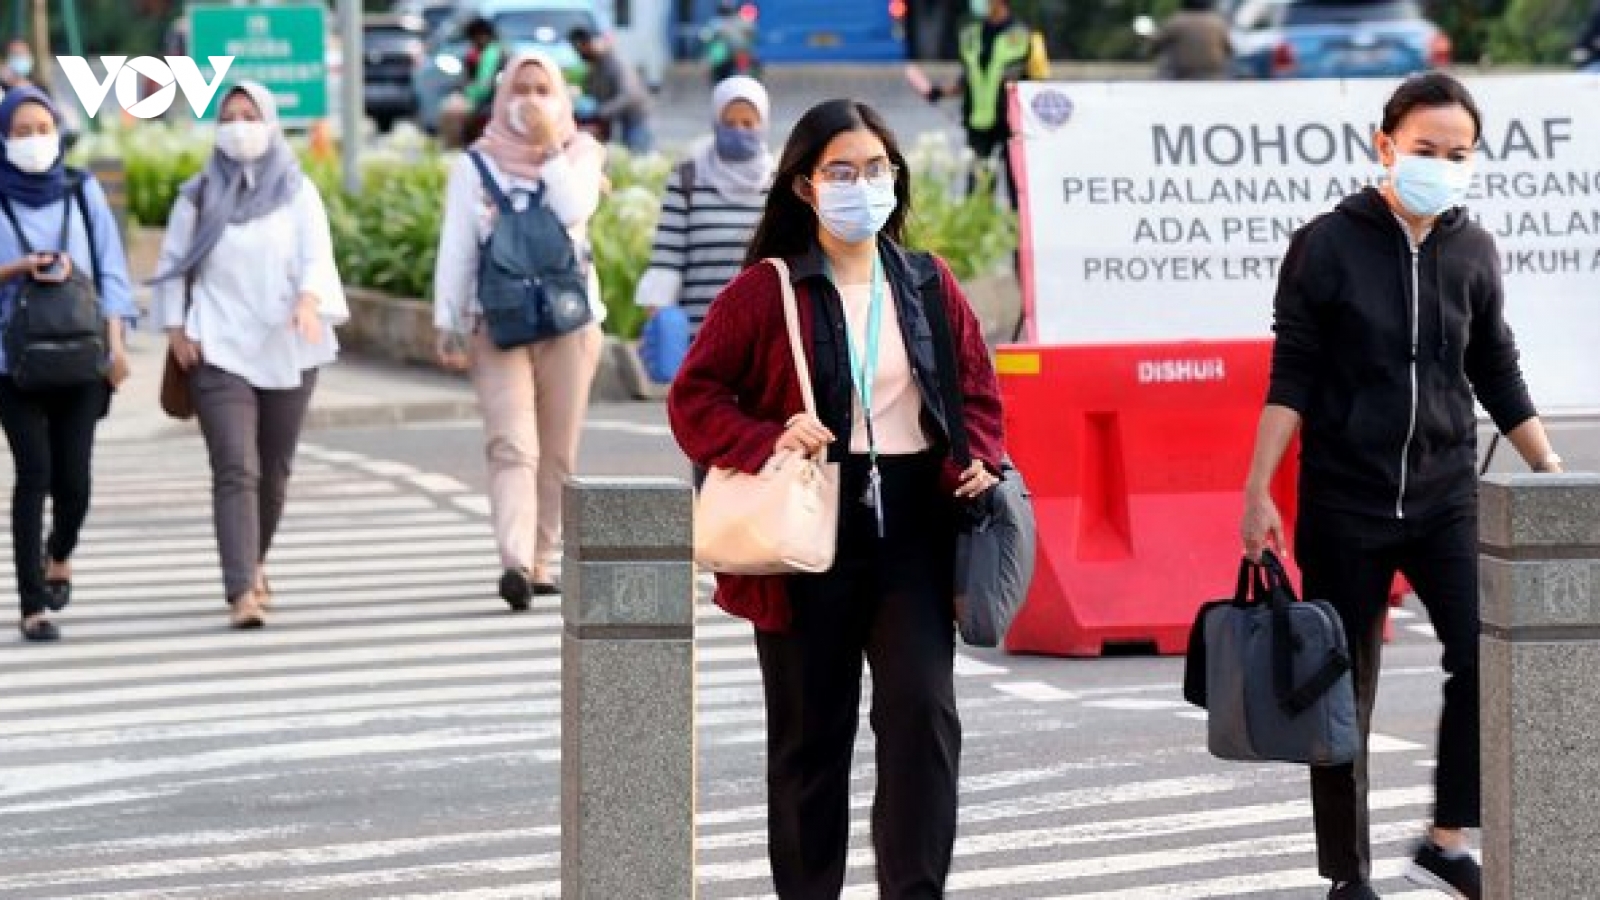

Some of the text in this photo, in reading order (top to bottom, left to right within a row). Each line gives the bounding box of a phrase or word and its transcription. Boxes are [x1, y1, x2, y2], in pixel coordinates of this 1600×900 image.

[1151, 122, 1380, 167] MOHON
[1062, 171, 1600, 205] PERJALANAN AN ERGAN
[1132, 216, 1211, 244] ADA
[1222, 216, 1306, 243] PEN
[1083, 255, 1213, 282] PROYEK
[1223, 255, 1281, 281] LRT
